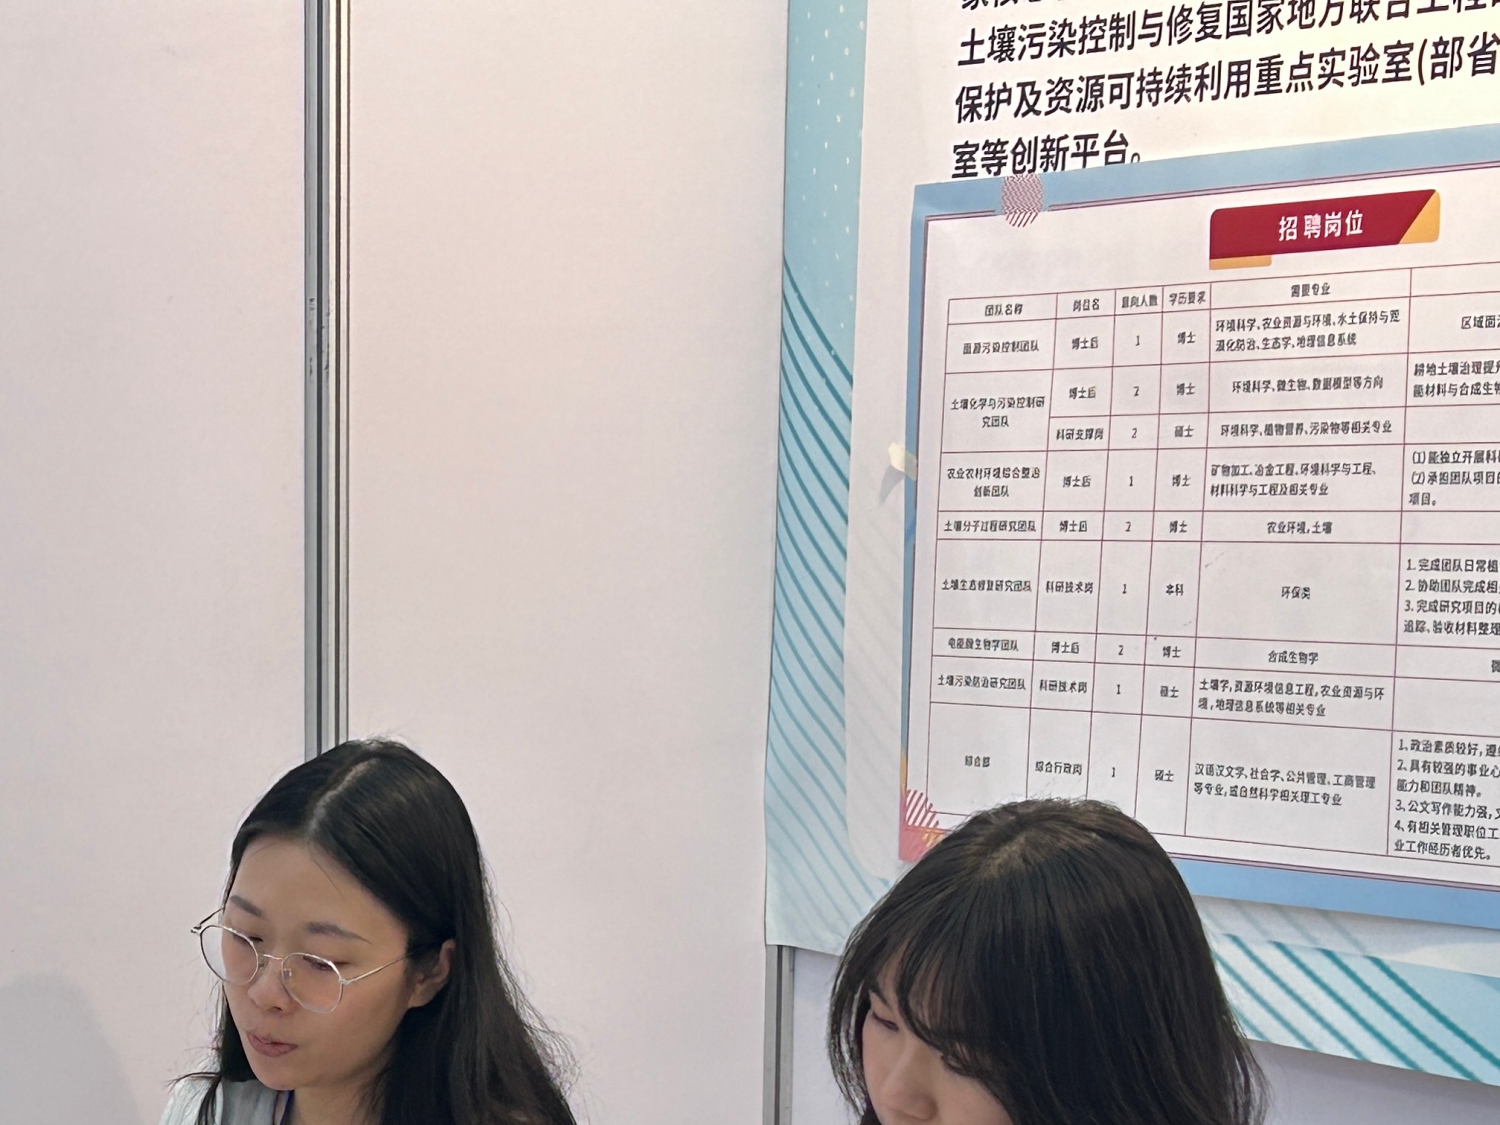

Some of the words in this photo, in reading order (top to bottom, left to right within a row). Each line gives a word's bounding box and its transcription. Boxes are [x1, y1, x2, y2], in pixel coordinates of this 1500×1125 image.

[958, 0, 1500, 66] 土壤污染控制与修复国家地方联
[1279, 209, 1363, 241] 招聘岗位
[1460, 314, 1500, 330] 区域面
[1135, 334, 1141, 347] 1
[1133, 385, 1140, 397] 2
[1131, 427, 1138, 439] 2
[1129, 475, 1134, 487] 1
[1124, 520, 1132, 533] 2
[1121, 583, 1128, 595] 1
[1117, 644, 1124, 656] 2
[1116, 683, 1121, 696] 1
[1111, 766, 1116, 778] 1
